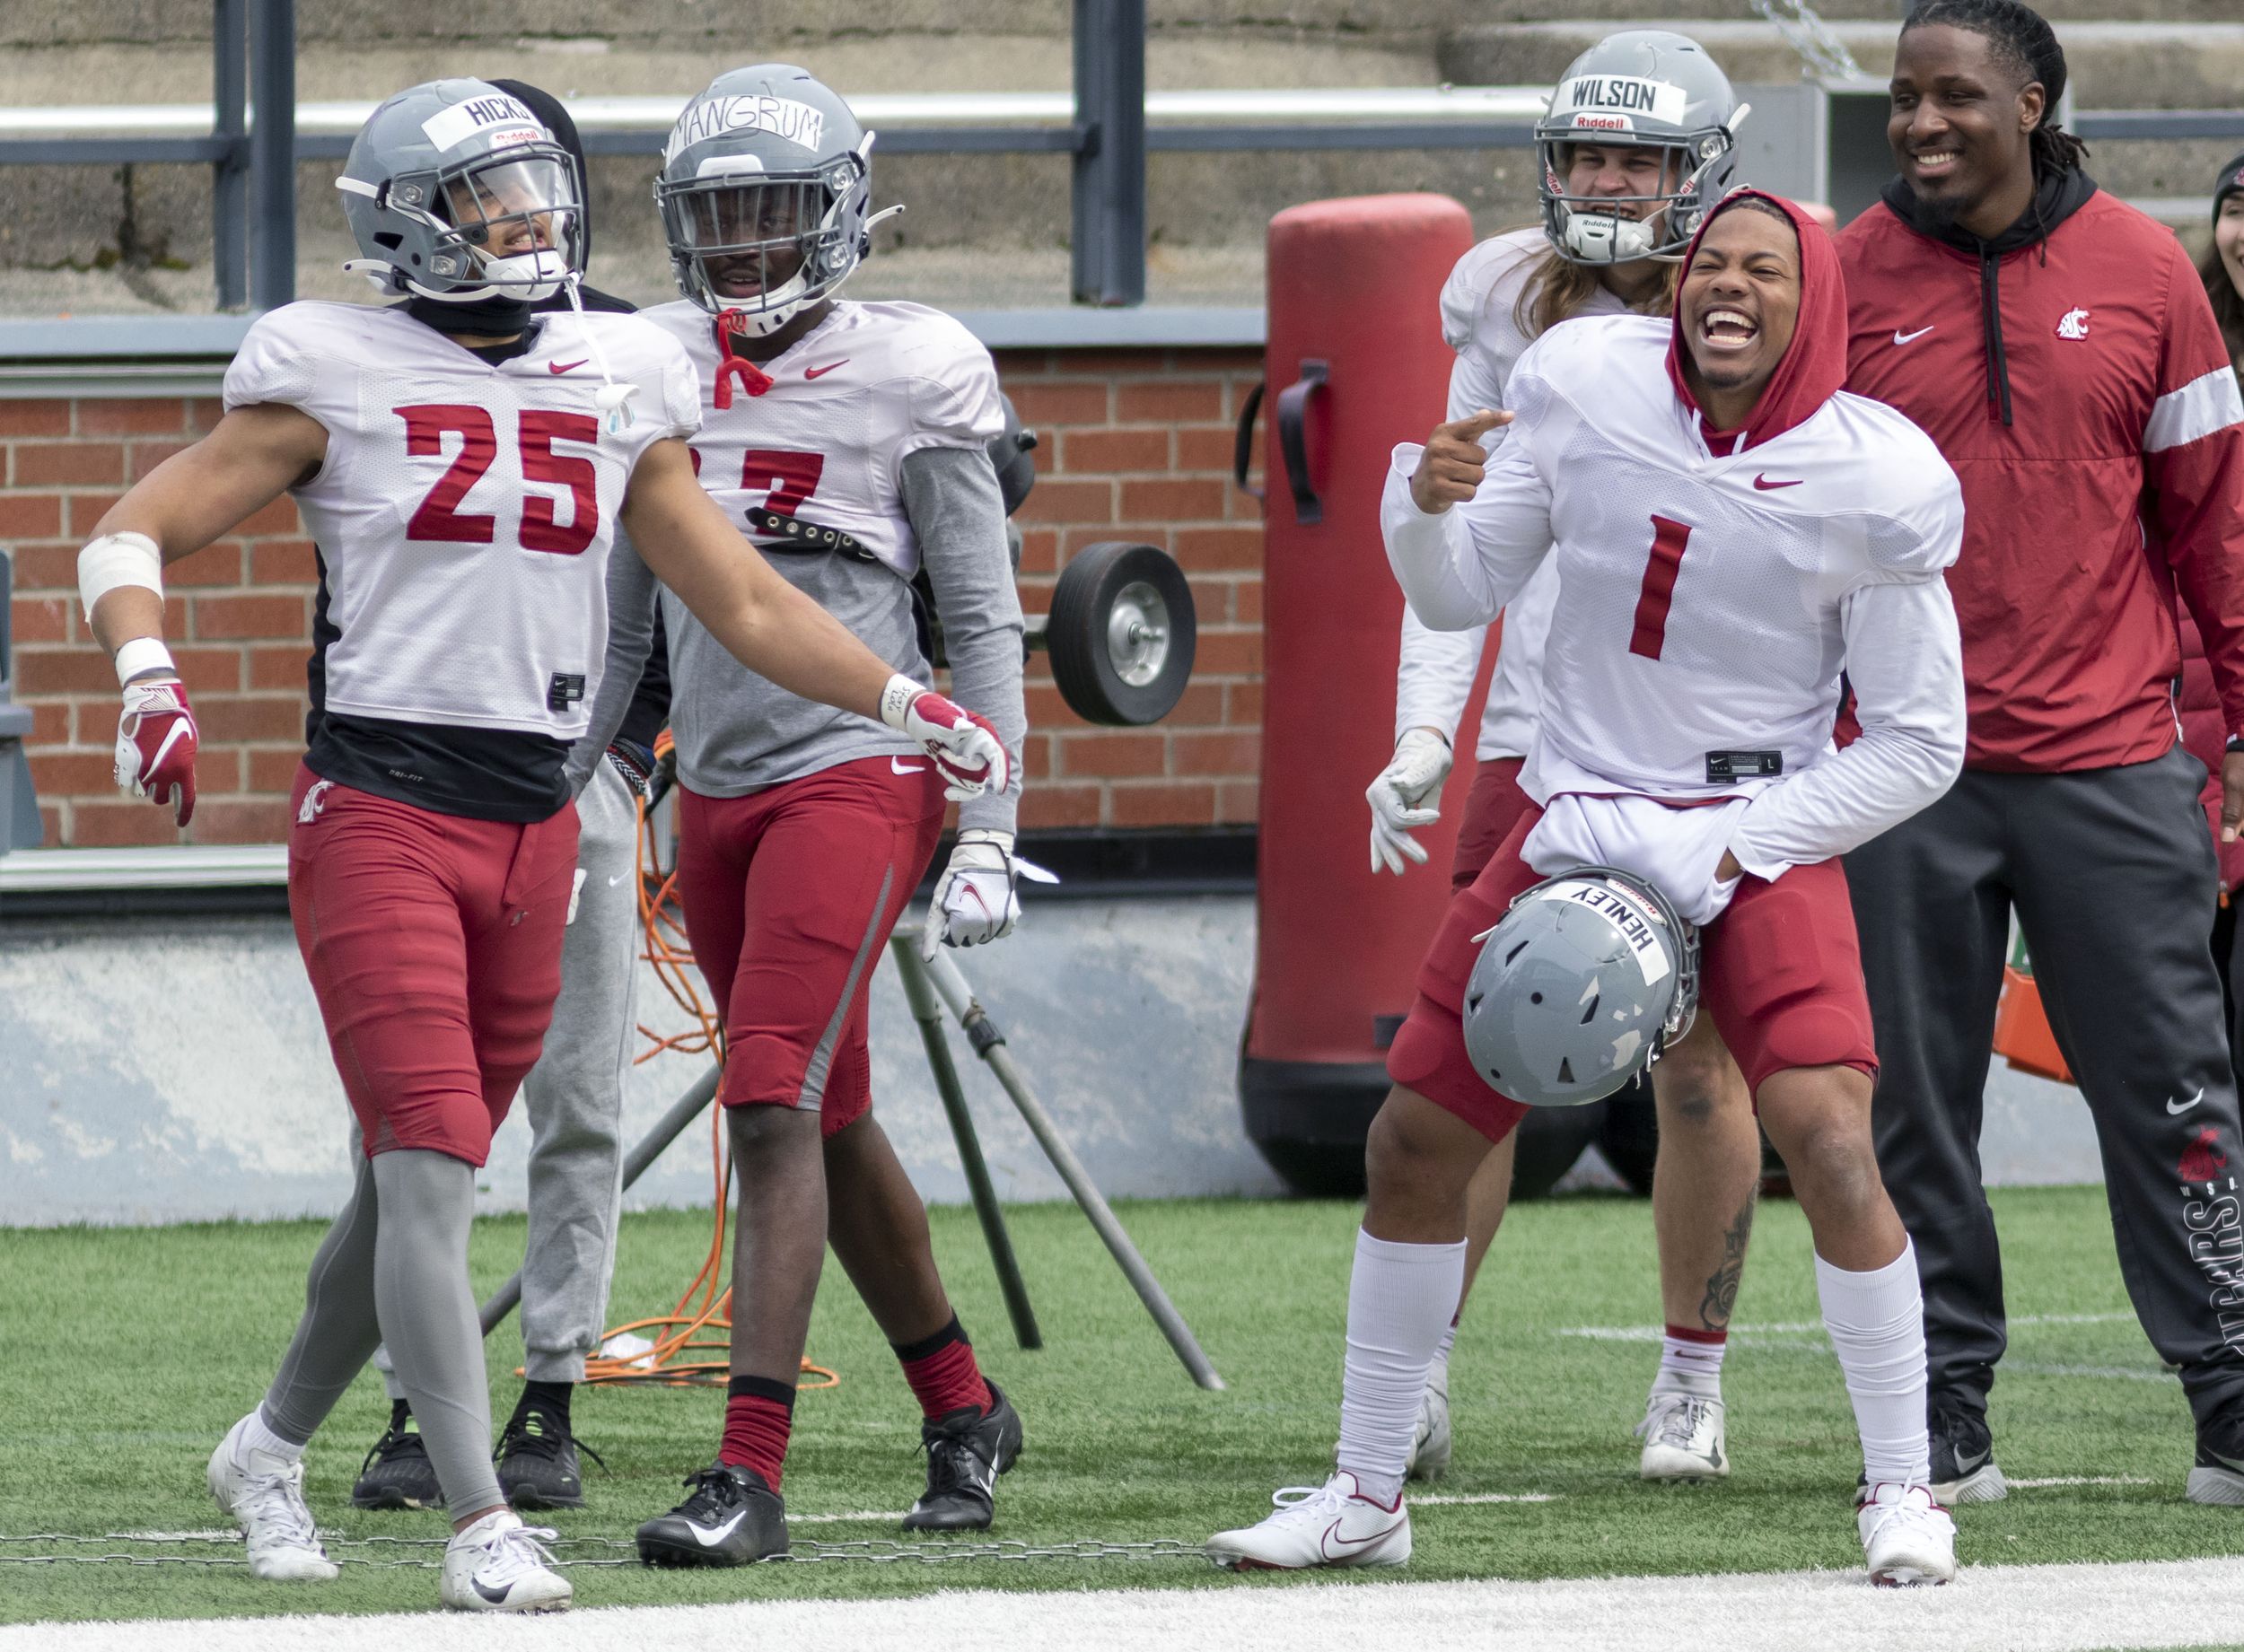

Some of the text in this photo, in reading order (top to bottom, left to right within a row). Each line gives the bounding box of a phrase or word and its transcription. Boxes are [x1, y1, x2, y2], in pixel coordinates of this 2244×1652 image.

[463, 97, 530, 127] HICKS
[1572, 79, 1656, 112] WILSON
[675, 95, 820, 147] MANGRUM
[1577, 117, 1623, 129] Riddell
[391, 403, 600, 556] 25
[1628, 513, 1693, 662] 1
[1766, 757, 1775, 769] L
[1572, 887, 1654, 953] HENLEY
